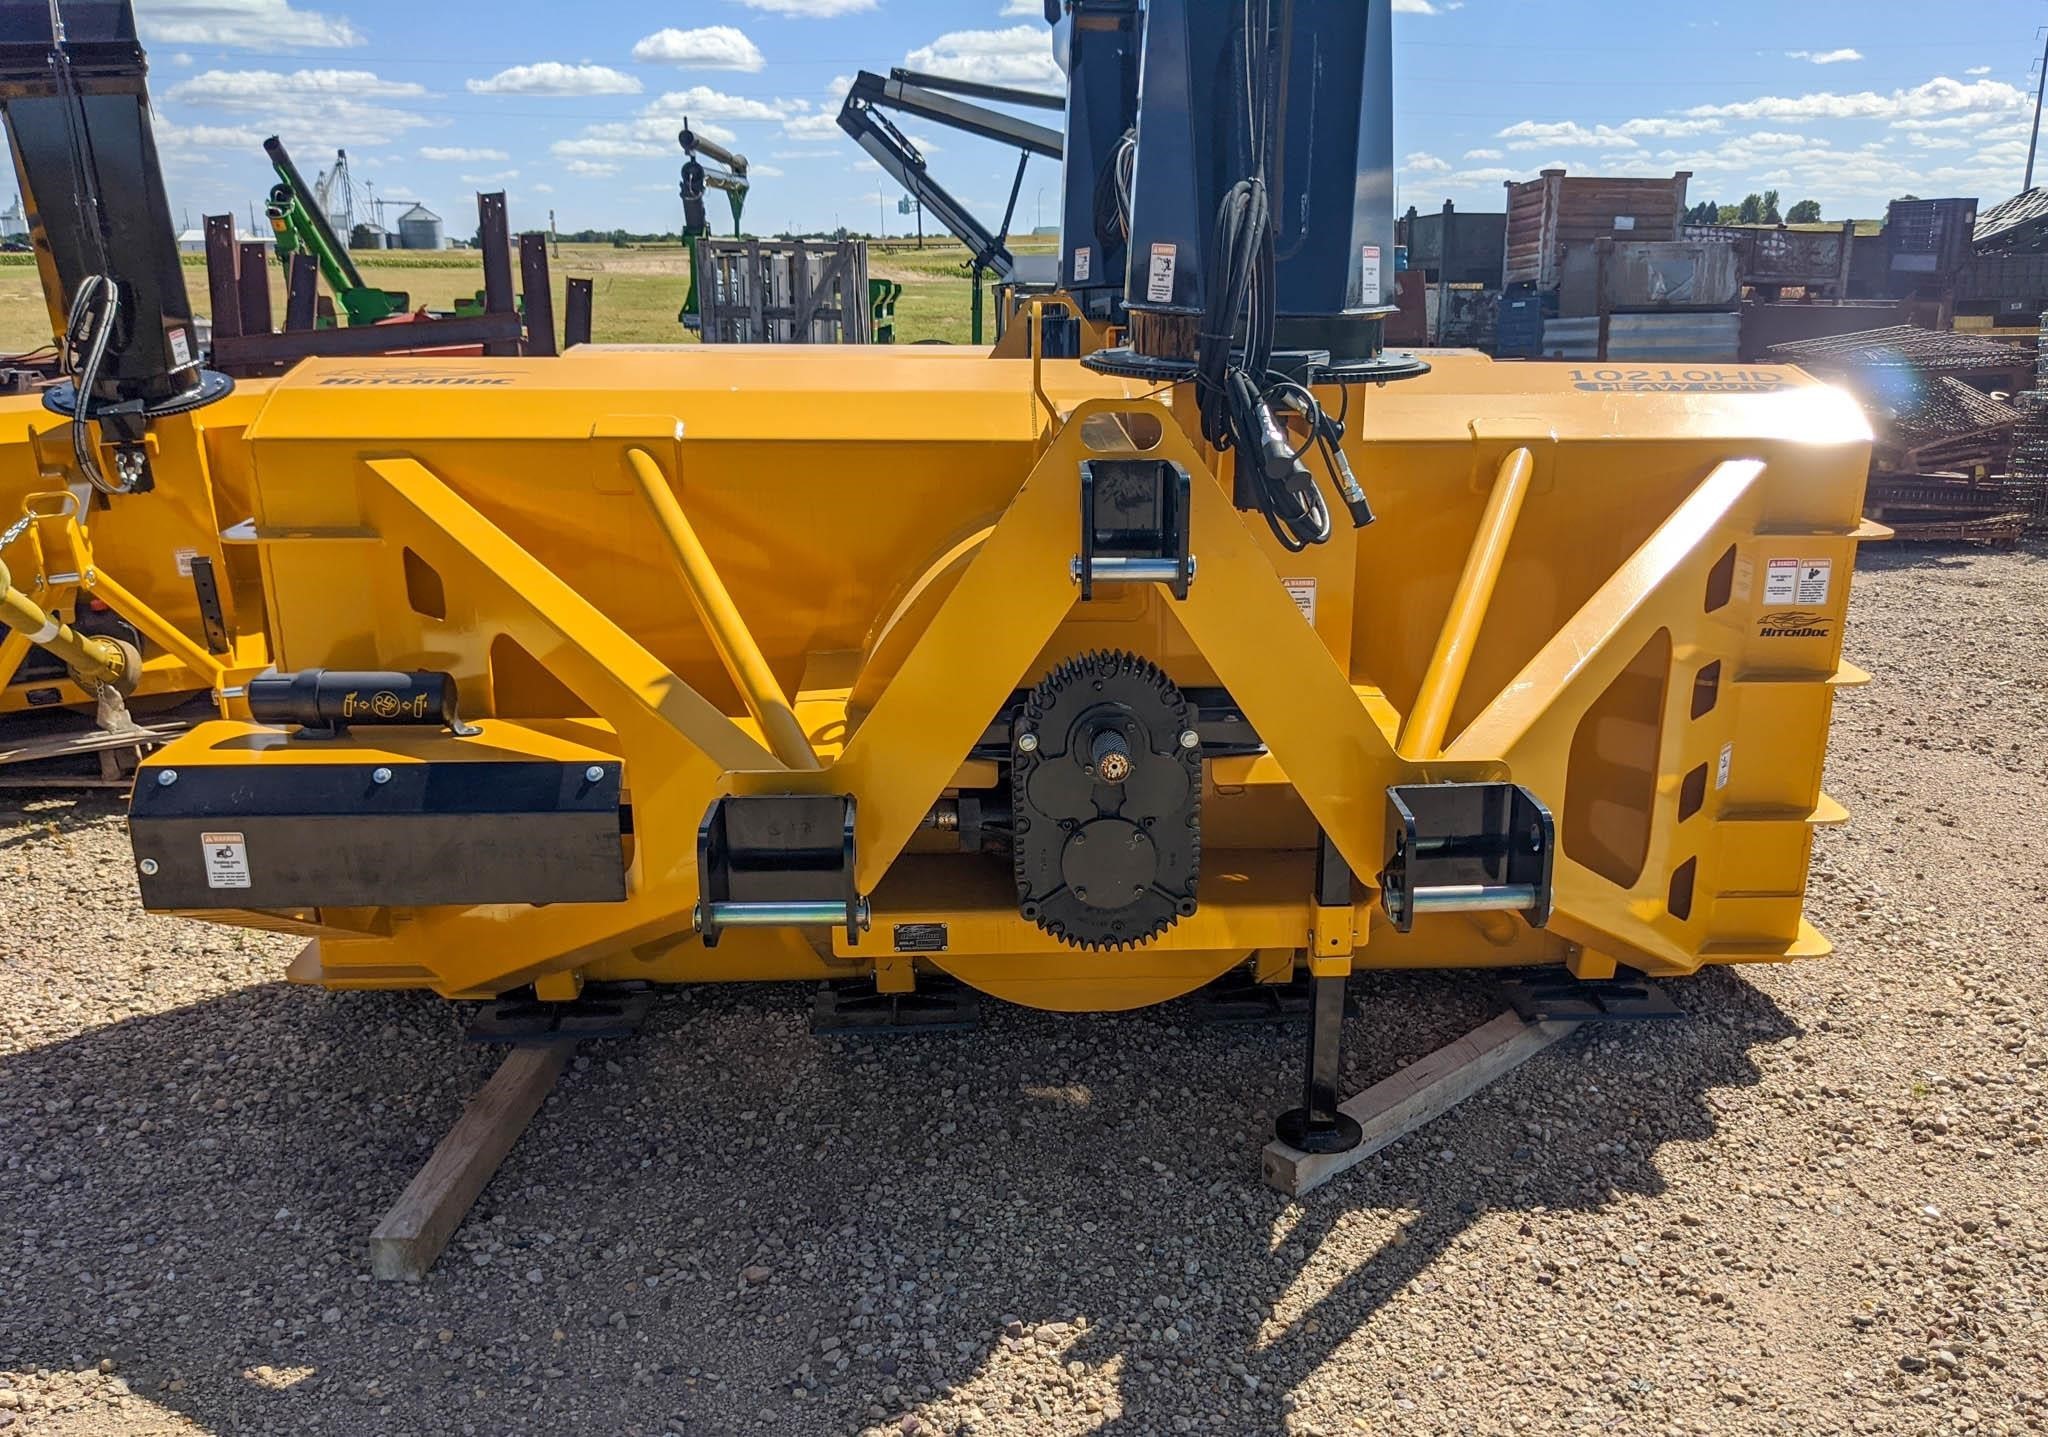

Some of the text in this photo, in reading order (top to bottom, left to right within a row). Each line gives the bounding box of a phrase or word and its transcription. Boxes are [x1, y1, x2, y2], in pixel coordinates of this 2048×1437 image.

[1567, 369, 1784, 382] 10210HD
[1597, 383, 1779, 391] HEAVY DUTY
